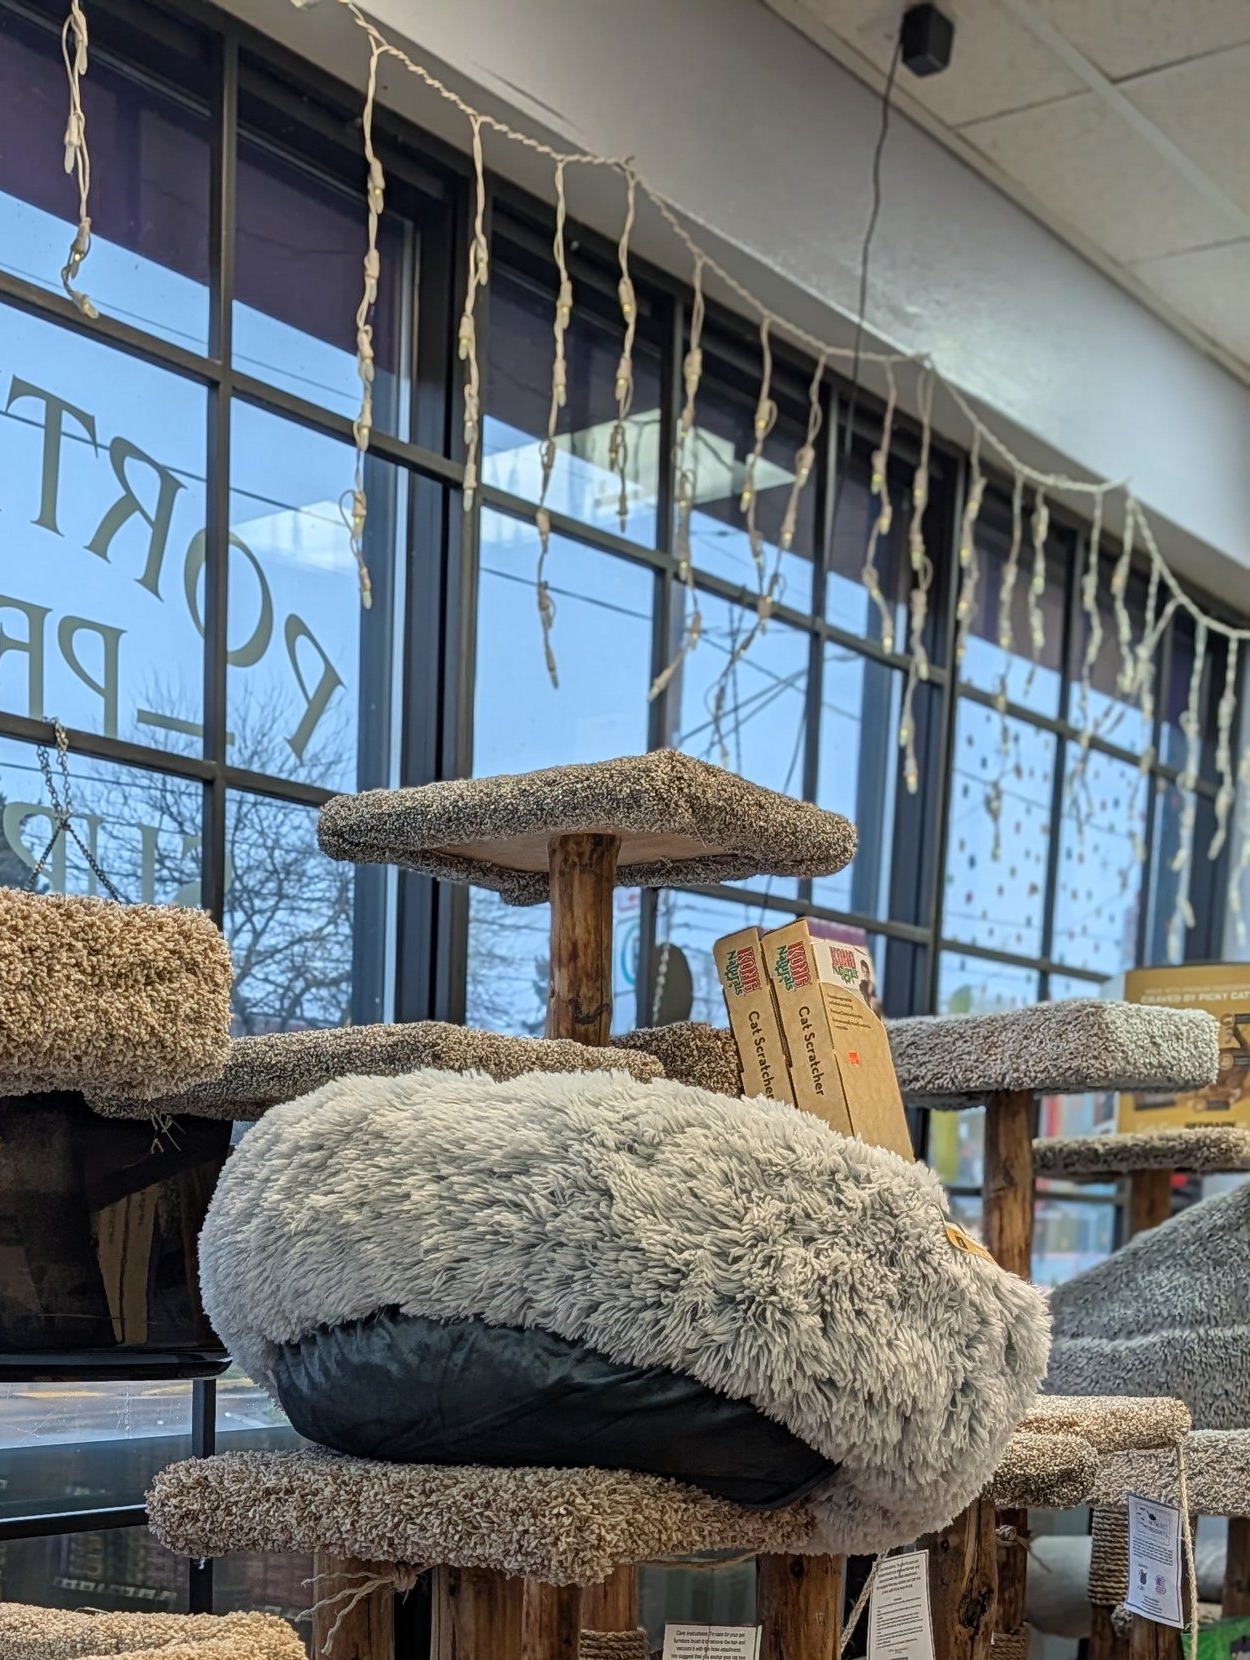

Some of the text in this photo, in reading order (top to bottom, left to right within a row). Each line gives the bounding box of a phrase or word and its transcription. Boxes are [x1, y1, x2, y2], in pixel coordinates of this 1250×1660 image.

[724, 950, 744, 996] Naturals
[737, 946, 761, 994] KONG
[774, 945, 794, 991] Naturals
[788, 940, 811, 988] KONG
[748, 1010, 774, 1099] Cat Scratcher
[799, 1006, 824, 1096] Cat Scratcher
